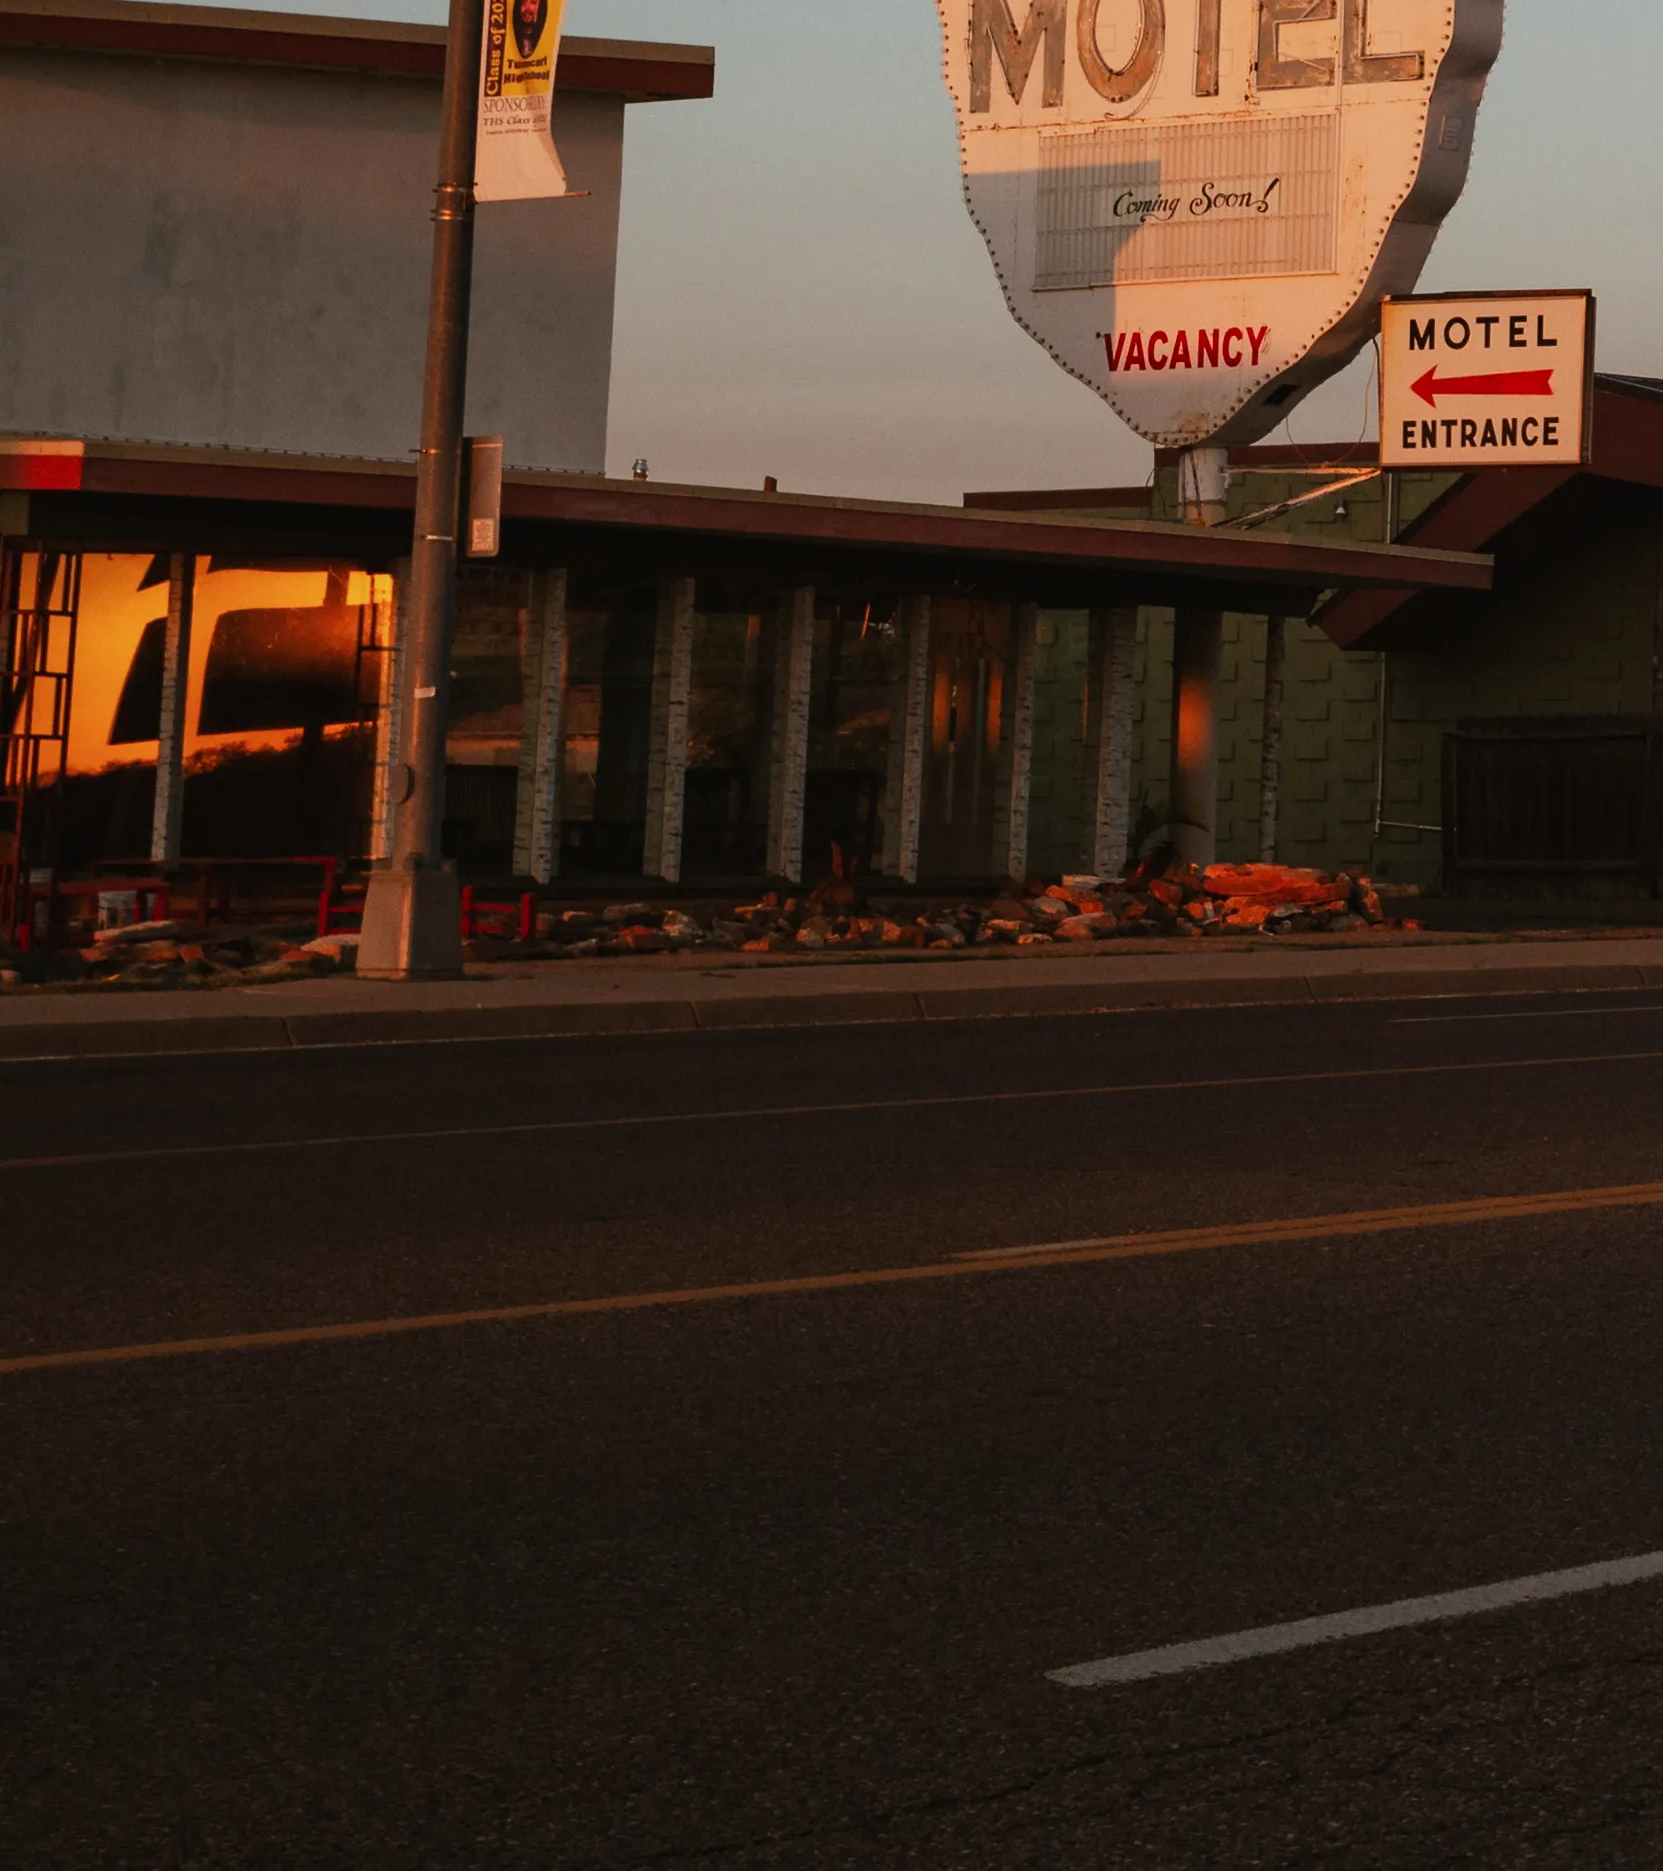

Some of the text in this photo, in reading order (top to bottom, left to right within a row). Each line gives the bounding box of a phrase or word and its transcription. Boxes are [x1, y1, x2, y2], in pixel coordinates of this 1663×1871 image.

[491, 27, 506, 45] of
[486, 49, 501, 95] Class
[1113, 177, 1280, 222] Coming Soon!
[1104, 326, 1269, 373] VACANCY
[1409, 314, 1558, 351] MOTEL
[1402, 416, 1560, 450] ENTRANCE
